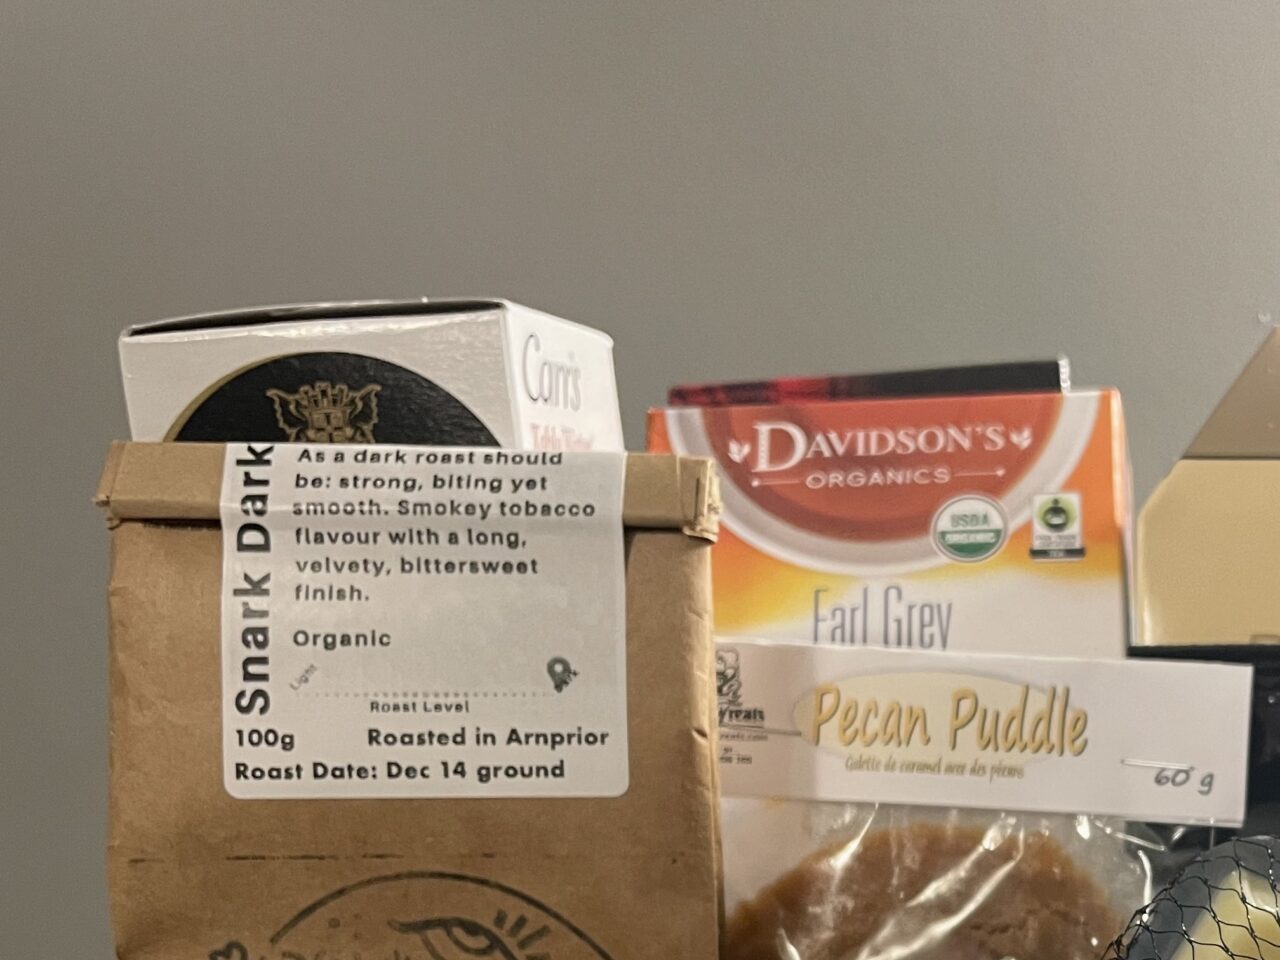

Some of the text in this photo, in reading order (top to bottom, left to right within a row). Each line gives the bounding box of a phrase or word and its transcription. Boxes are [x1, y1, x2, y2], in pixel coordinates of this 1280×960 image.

[297, 449, 563, 466] As a dark roast should
[752, 421, 1007, 473] DAVIDSON'S
[295, 474, 548, 494] be: strong, biting yet
[805, 468, 952, 489] ORGANICS
[293, 500, 595, 520] smooth. Smokey tobacco
[295, 528, 527, 549] flavour with a long,
[296, 557, 538, 577] velvety, bittersweet
[232, 445, 275, 715] Snark Dark
[295, 585, 369, 601] finish.
[813, 587, 868, 647] Earl
[293, 630, 391, 651] Organic
[289, 664, 318, 691] Light
[370, 700, 470, 713] Roast Level
[810, 682, 1089, 757] Pecan Puddle
[235, 727, 609, 751] 100g Roasted in Arnprior
[235, 759, 565, 784] Roast Date: Dec 14 ground
[884, 755, 897, 773] de
[900, 756, 942, 776] caramel
